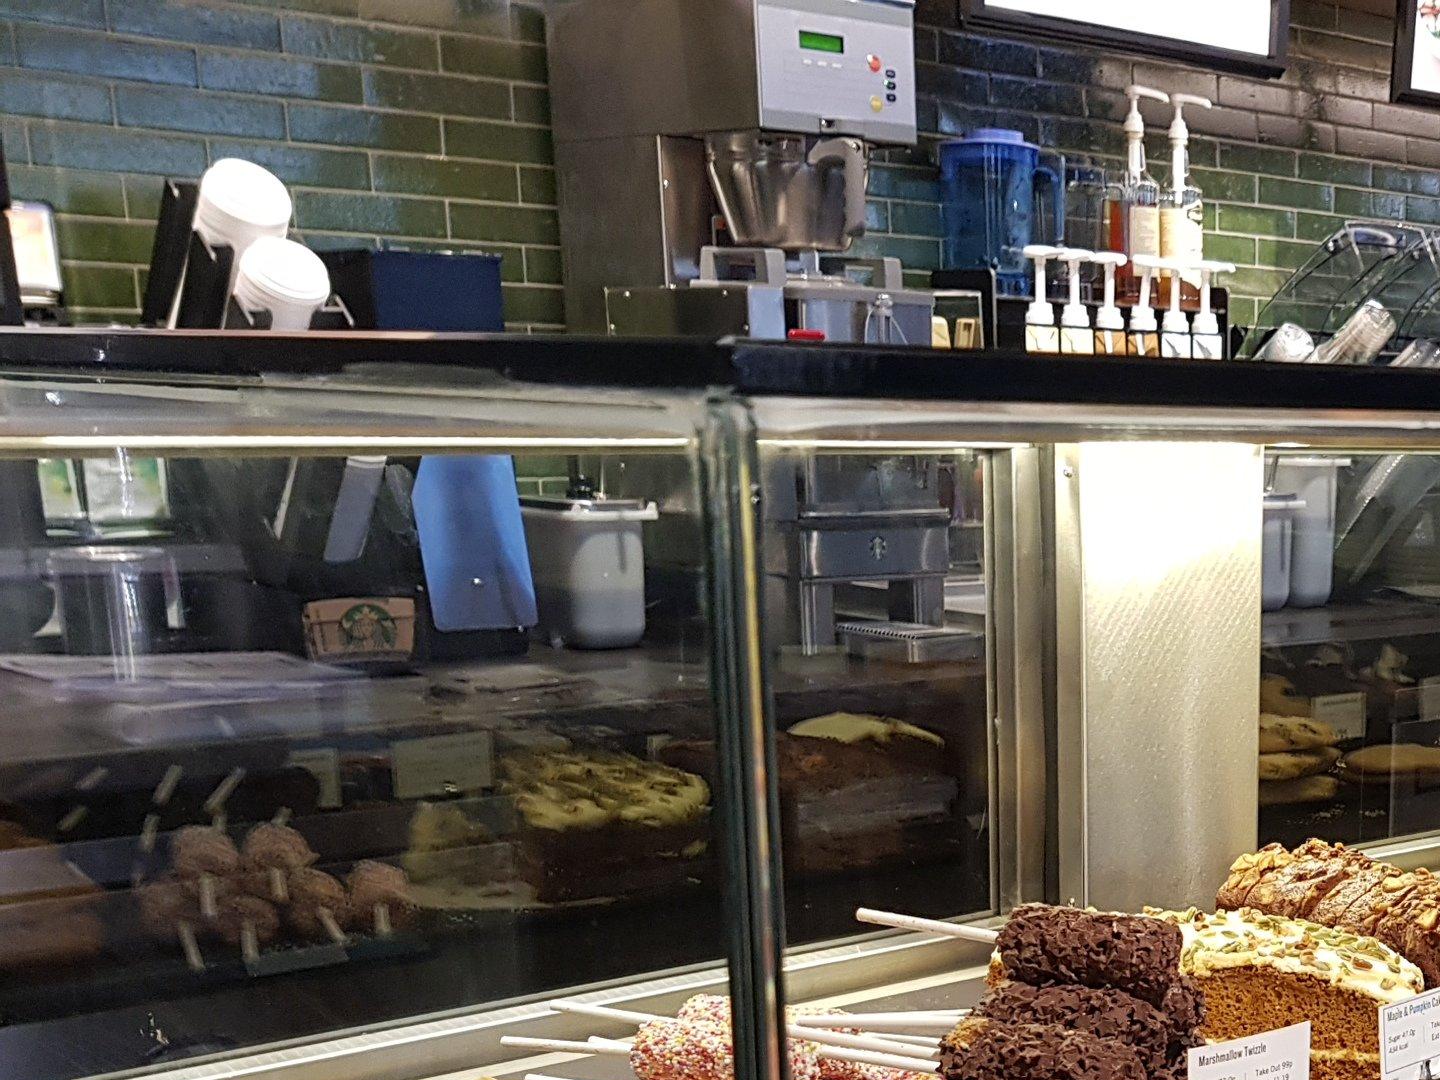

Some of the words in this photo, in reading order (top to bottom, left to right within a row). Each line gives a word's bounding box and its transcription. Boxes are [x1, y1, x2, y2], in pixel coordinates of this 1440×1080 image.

[1387, 1007, 1403, 1022] Maple
[1404, 1007, 1409, 1016] &
[1409, 1000, 1431, 1016] Pumpkin
[1431, 1032, 1440, 1041] Eat
[1198, 1048, 1243, 1067] Marshmallow
[1244, 1042, 1267, 1058] Twizzle
[1255, 1068, 1269, 1077] Take
[1270, 1064, 1281, 1073] Out
[1281, 1060, 1293, 1070] 99p
